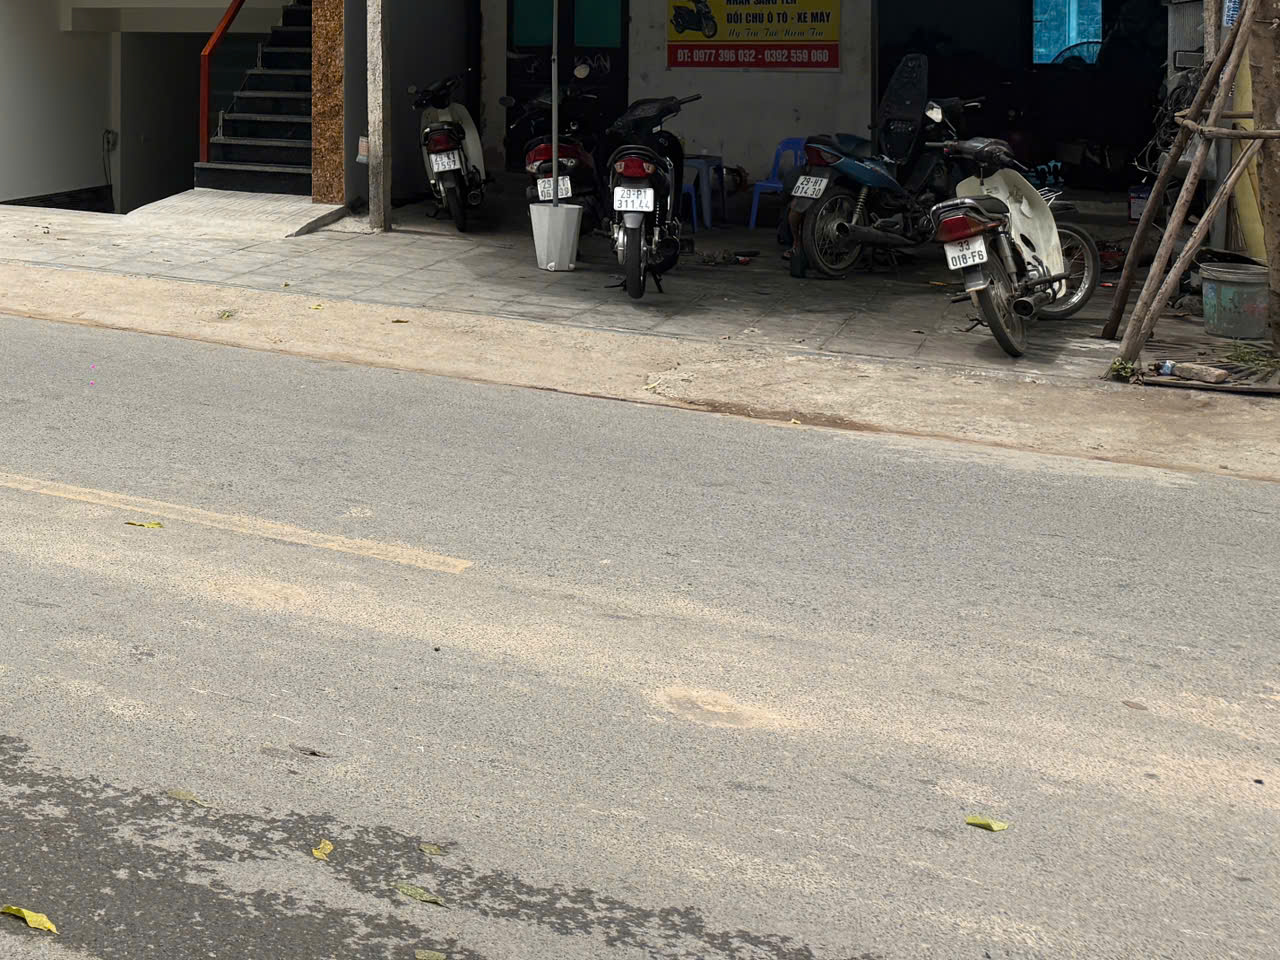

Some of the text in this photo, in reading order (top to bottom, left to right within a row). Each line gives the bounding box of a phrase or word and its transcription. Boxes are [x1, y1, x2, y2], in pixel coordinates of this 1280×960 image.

[797, 12, 808, 23] XE
[693, 49, 716, 62] 0977
[718, 49, 736, 62] 396
[738, 49, 756, 62] 032
[764, 49, 789, 62] 0392
[791, 49, 808, 62] 559
[811, 49, 829, 62] 060
[957, 239, 971, 252] 33
